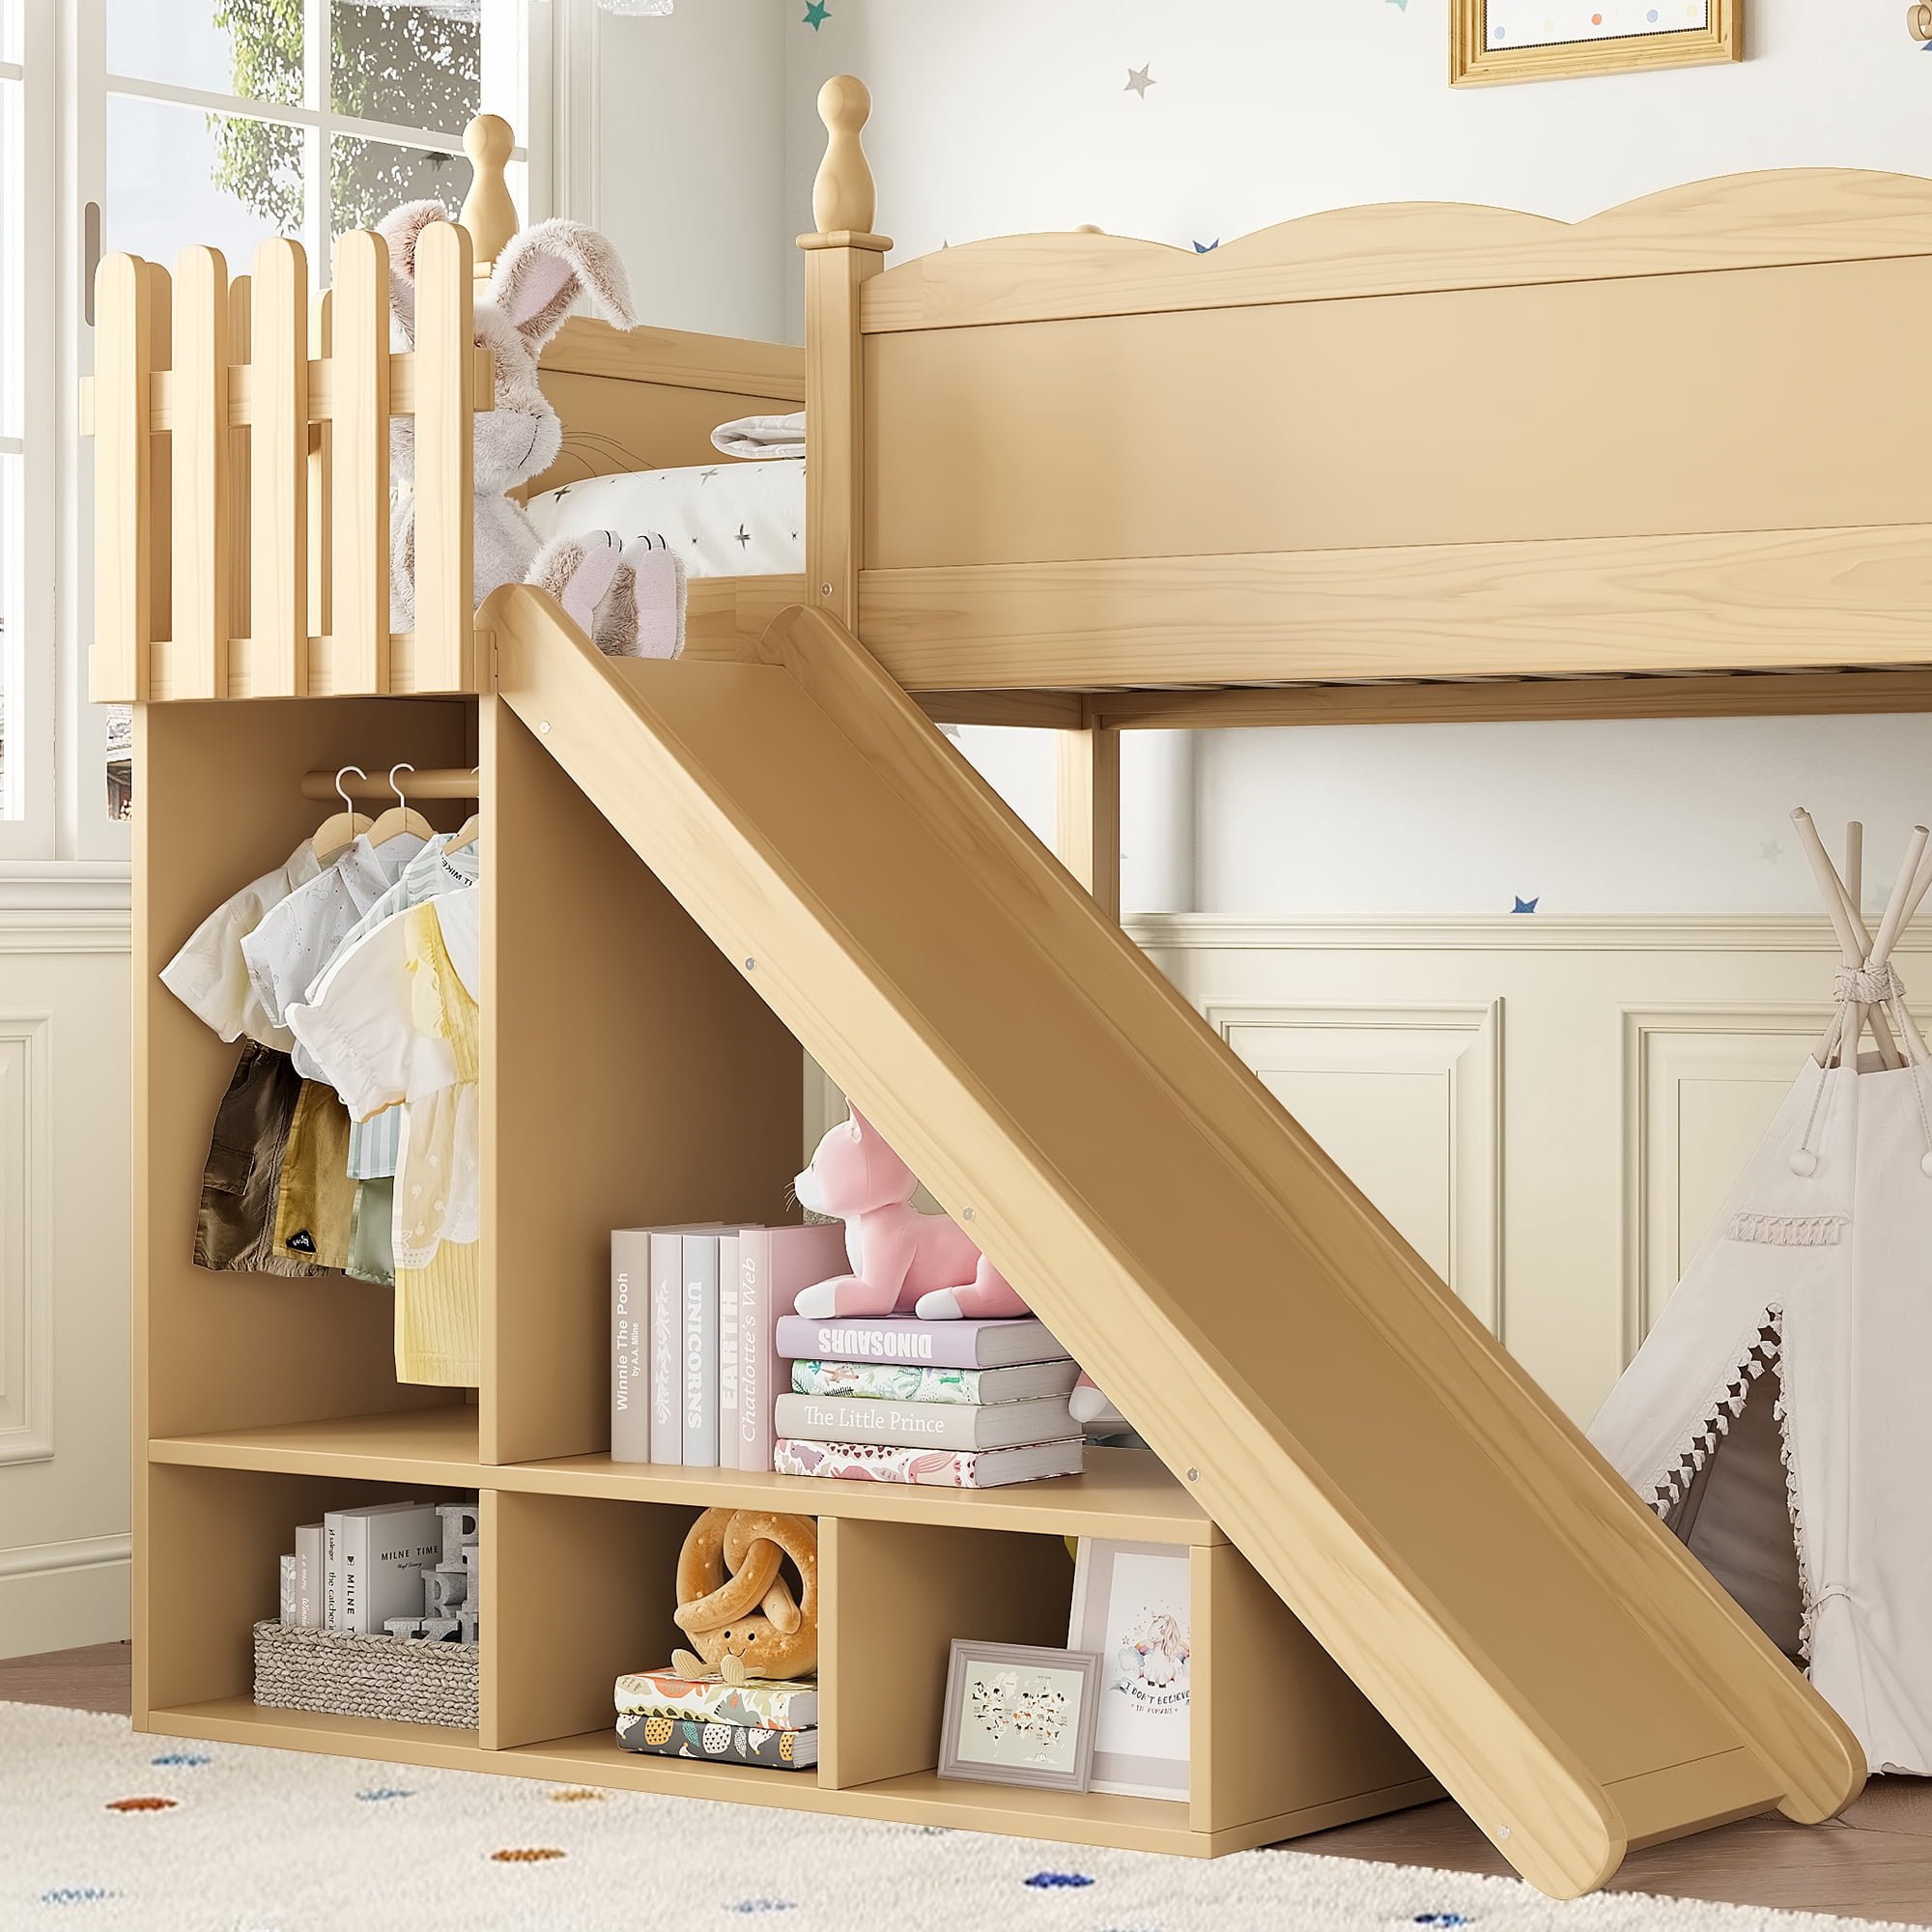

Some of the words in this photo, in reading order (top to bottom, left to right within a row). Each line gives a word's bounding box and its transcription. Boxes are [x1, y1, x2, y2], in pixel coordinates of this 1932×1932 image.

[616, 1272, 629, 1315] Pooh
[741, 1258, 756, 1306] Web
[616, 1320, 629, 1350] The
[722, 1291, 738, 1409] EARTH
[818, 1327, 932, 1359] DINOSAURS
[631, 1347, 639, 1364] A.A.
[687, 1280, 702, 1429] UNICORNS
[616, 1354, 629, 1411] Winnie
[631, 1366, 640, 1377] by
[804, 1406, 834, 1427] The
[838, 1408, 884, 1430] Little
[890, 1412, 945, 1435] Prince
[381, 1549, 411, 1562] MILNE
[416, 1545, 439, 1556] TIME
[327, 1572, 337, 1587] the
[327, 1589, 337, 1624] catcher
